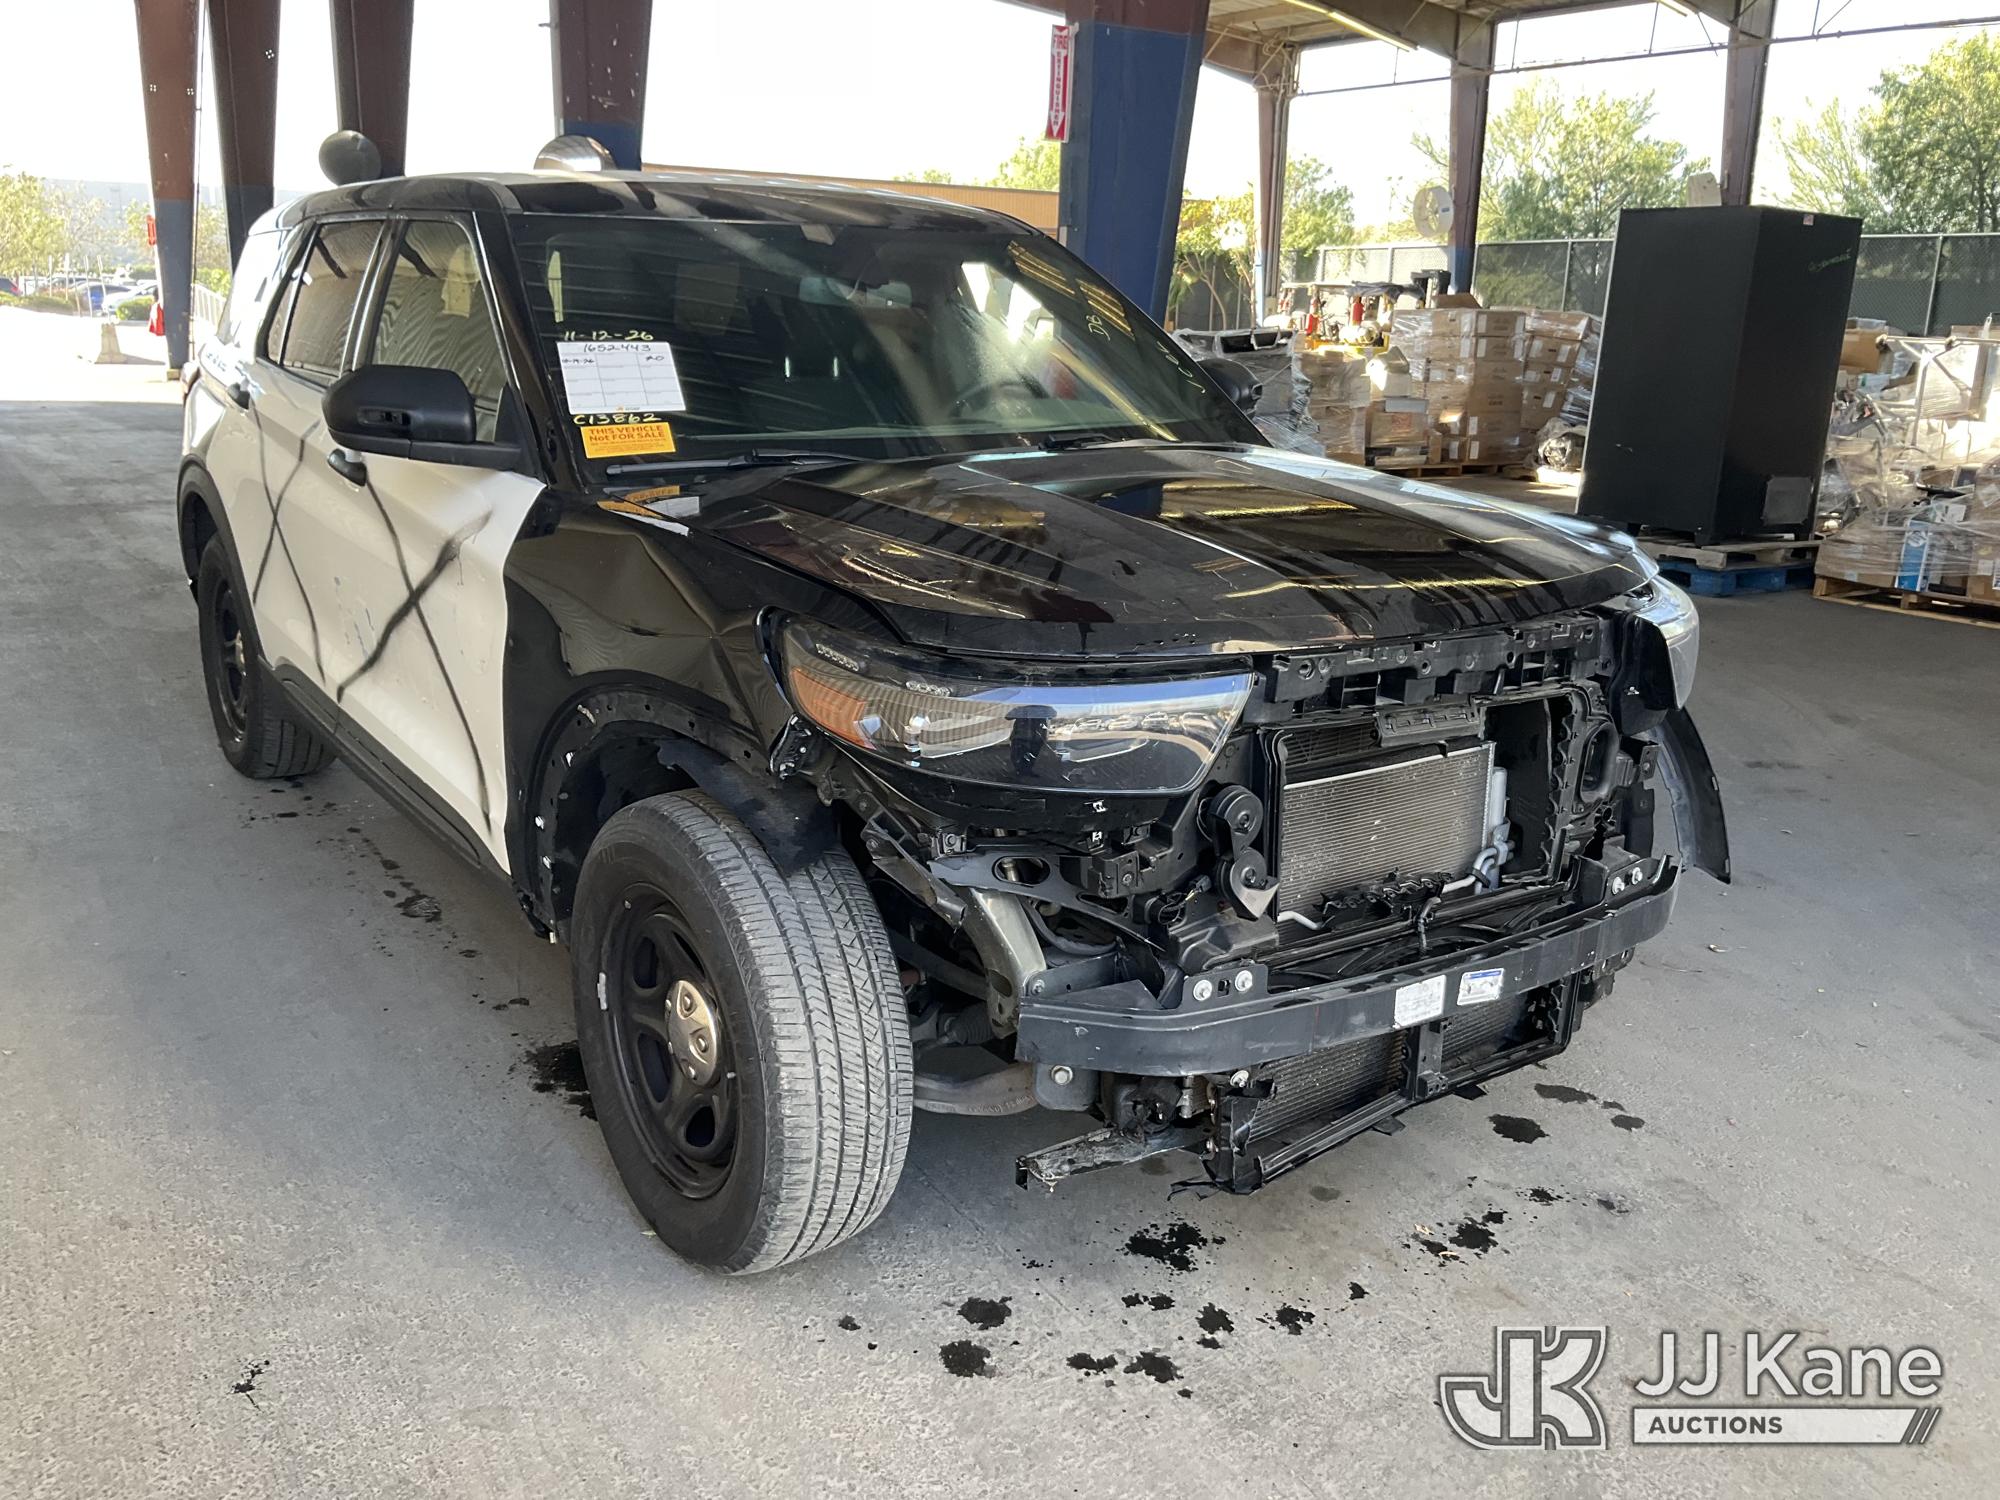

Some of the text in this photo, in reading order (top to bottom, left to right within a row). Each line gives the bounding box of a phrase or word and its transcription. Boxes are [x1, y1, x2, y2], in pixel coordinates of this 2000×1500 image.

[573, 412, 662, 424] C13862
[615, 425, 662, 434] VEHICLE
[612, 432, 635, 440] FOR
[637, 431, 665, 439] SALE
